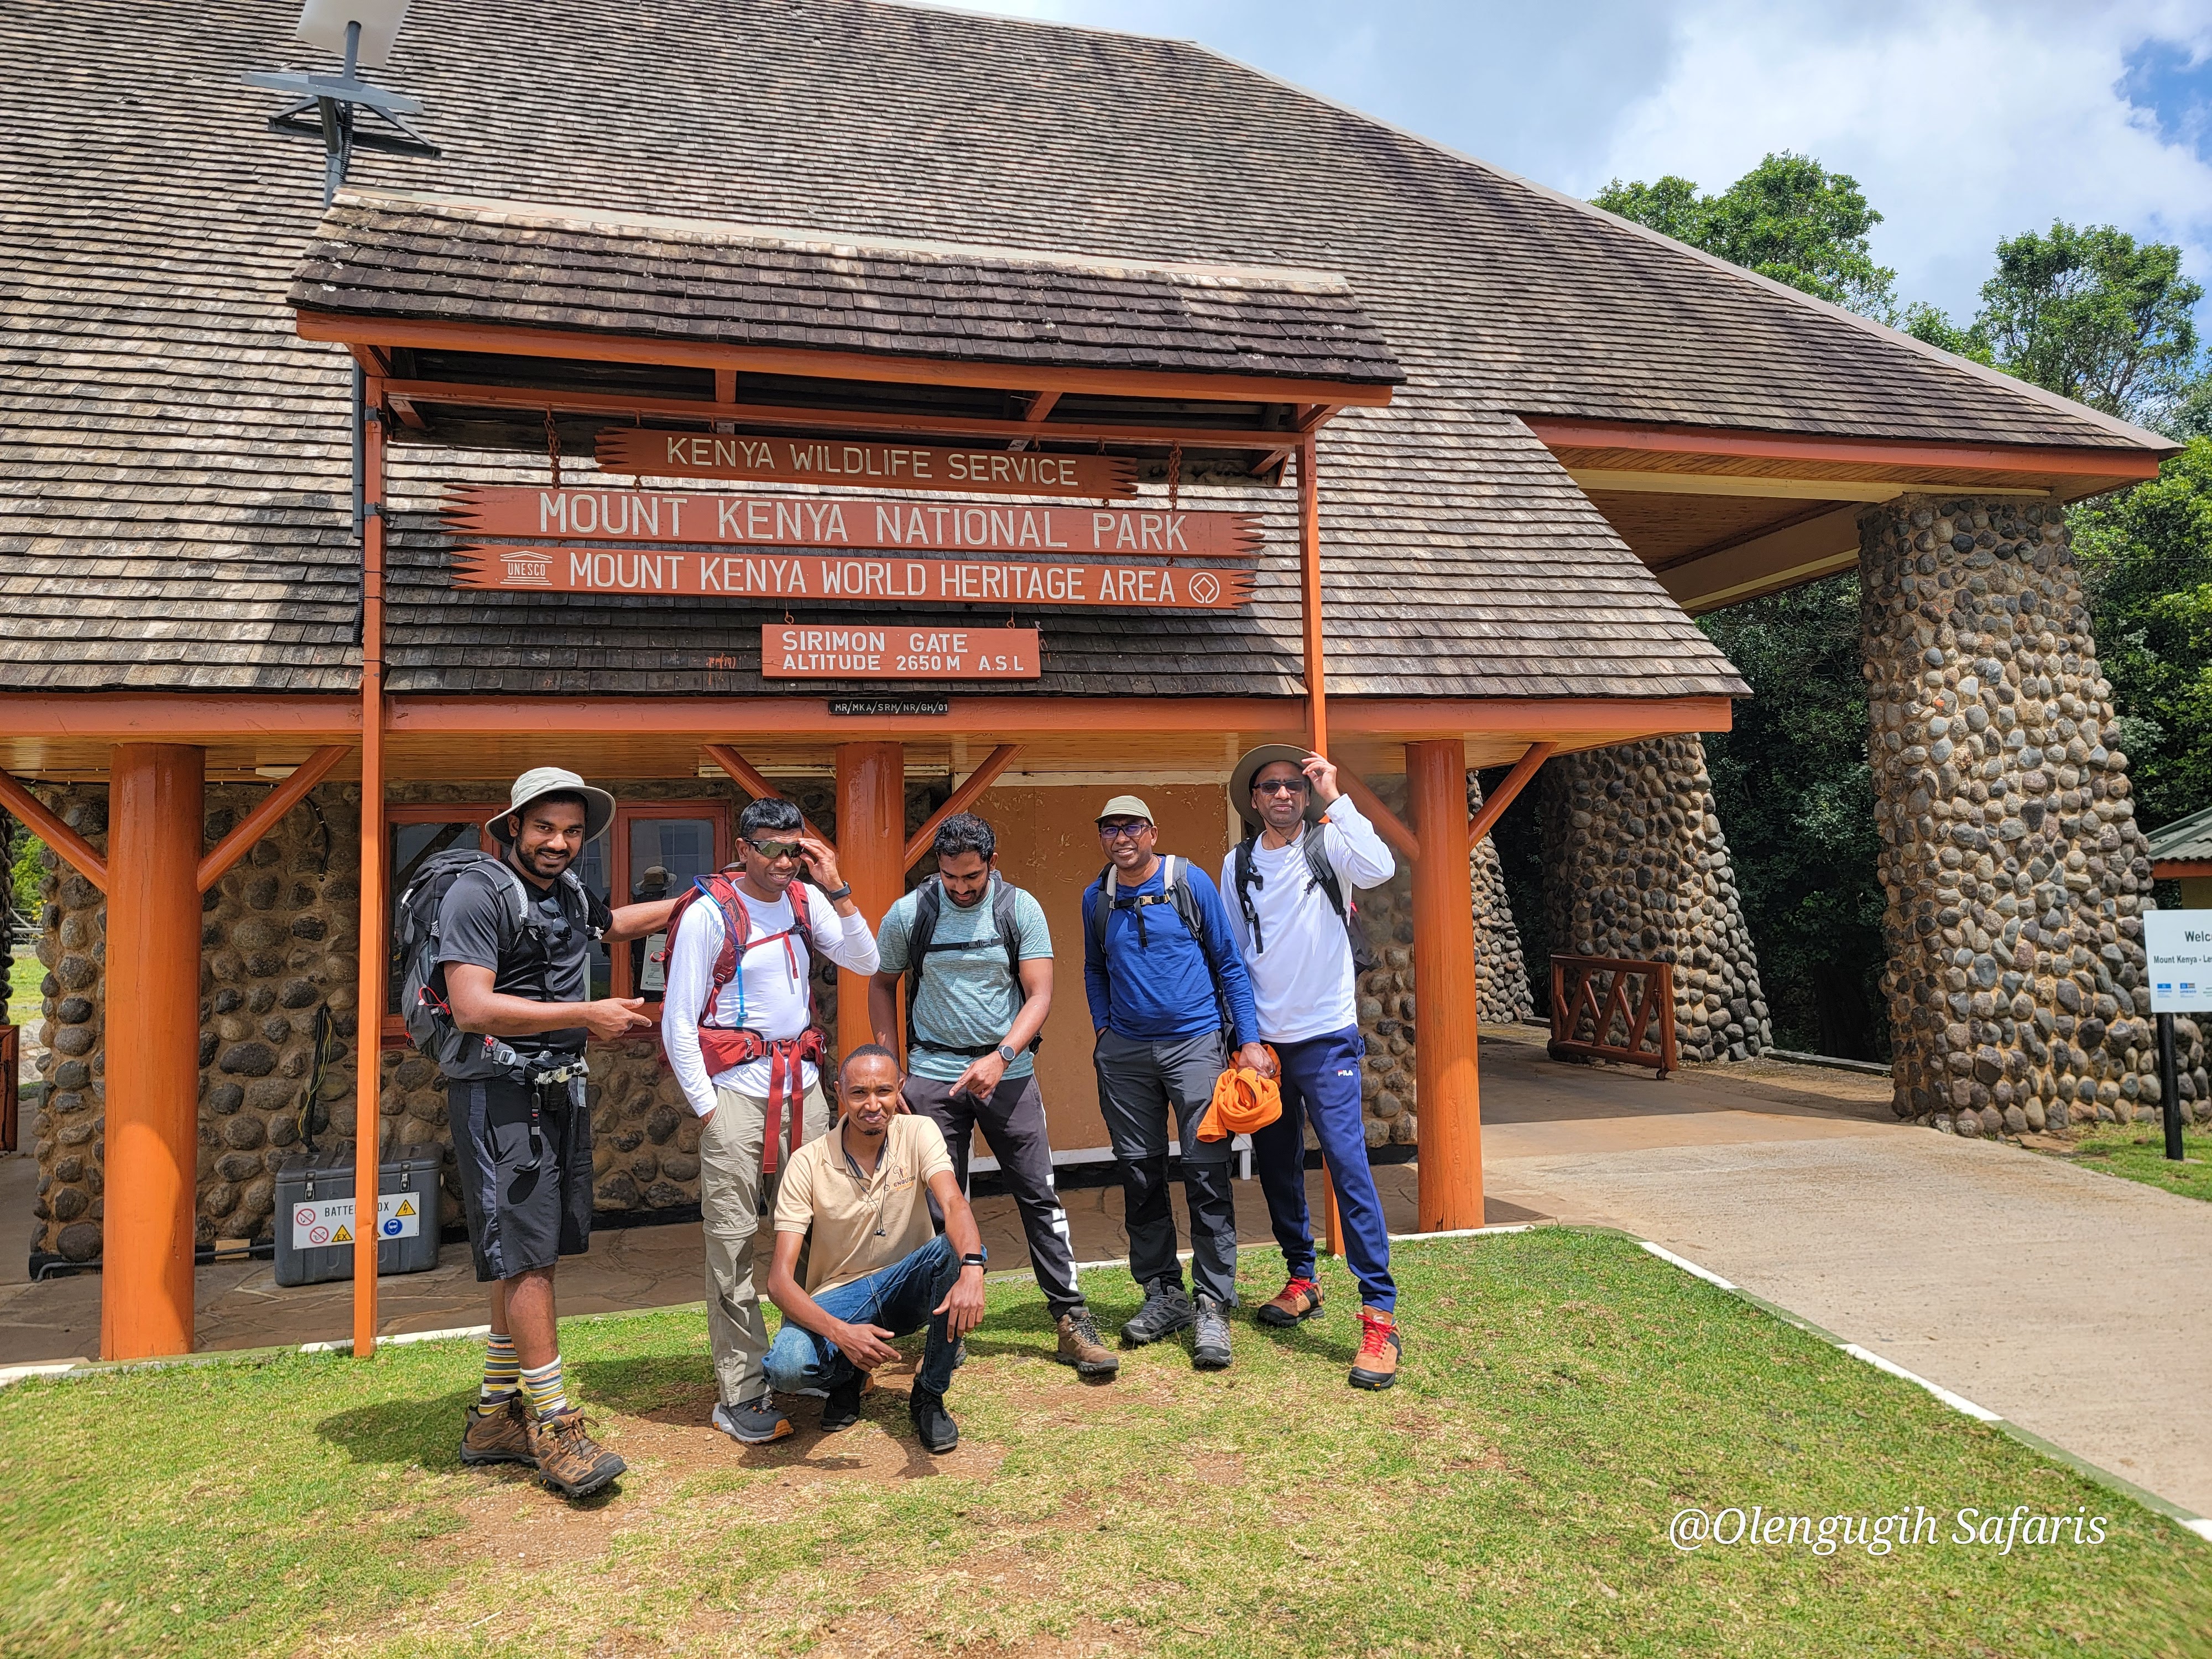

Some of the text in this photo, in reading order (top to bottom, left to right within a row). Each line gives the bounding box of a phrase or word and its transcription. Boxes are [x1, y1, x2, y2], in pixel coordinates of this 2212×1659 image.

[667, 436, 1078, 486] KENYA WILDLIFE SERVICE
[540, 492, 1188, 551] MOUNT KENYA NATIONAL PARK
[508, 562, 545, 576] UNESCO
[570, 552, 1176, 602] MOUNT KENYA WORLD HERITAGE AREA
[782, 630, 968, 653] SIRIMON GATE
[782, 654, 881, 670] ALTITUDE
[835, 701, 948, 714] MR/MKA/SRM/NR/GH/01
[2184, 930, 2212, 942] Welc
[2153, 955, 2175, 964] Mount
[2177, 955, 2198, 966] Kenya
[325, 1201, 389, 1217] BATTE OX
